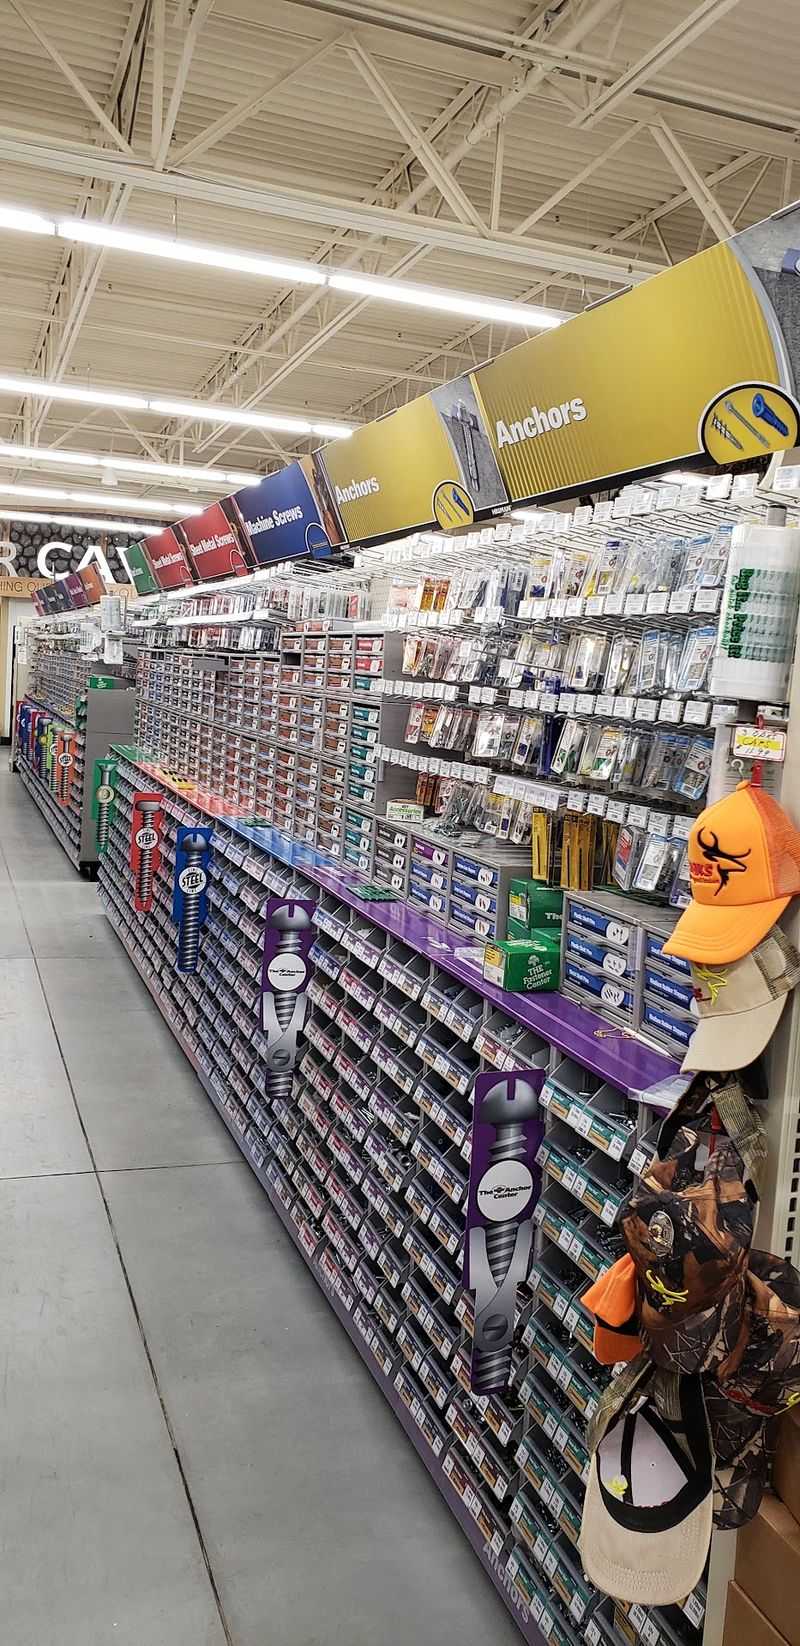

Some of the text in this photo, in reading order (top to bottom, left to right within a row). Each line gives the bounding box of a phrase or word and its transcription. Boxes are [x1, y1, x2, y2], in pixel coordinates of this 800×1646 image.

[496, 398, 587, 450] Anchors
[335, 476, 381, 505] Anchors
[271, 505, 304, 527] Screws
[138, 832, 156, 844] STEEL
[182, 872, 204, 888] STEEL
[523, 969, 552, 986] Fastener
[528, 964, 545, 977] THE
[526, 976, 551, 990] Center
[493, 1191, 519, 1200] Center
[504, 1185, 531, 1193] Anchor
[482, 1543, 530, 1623] Anchors
